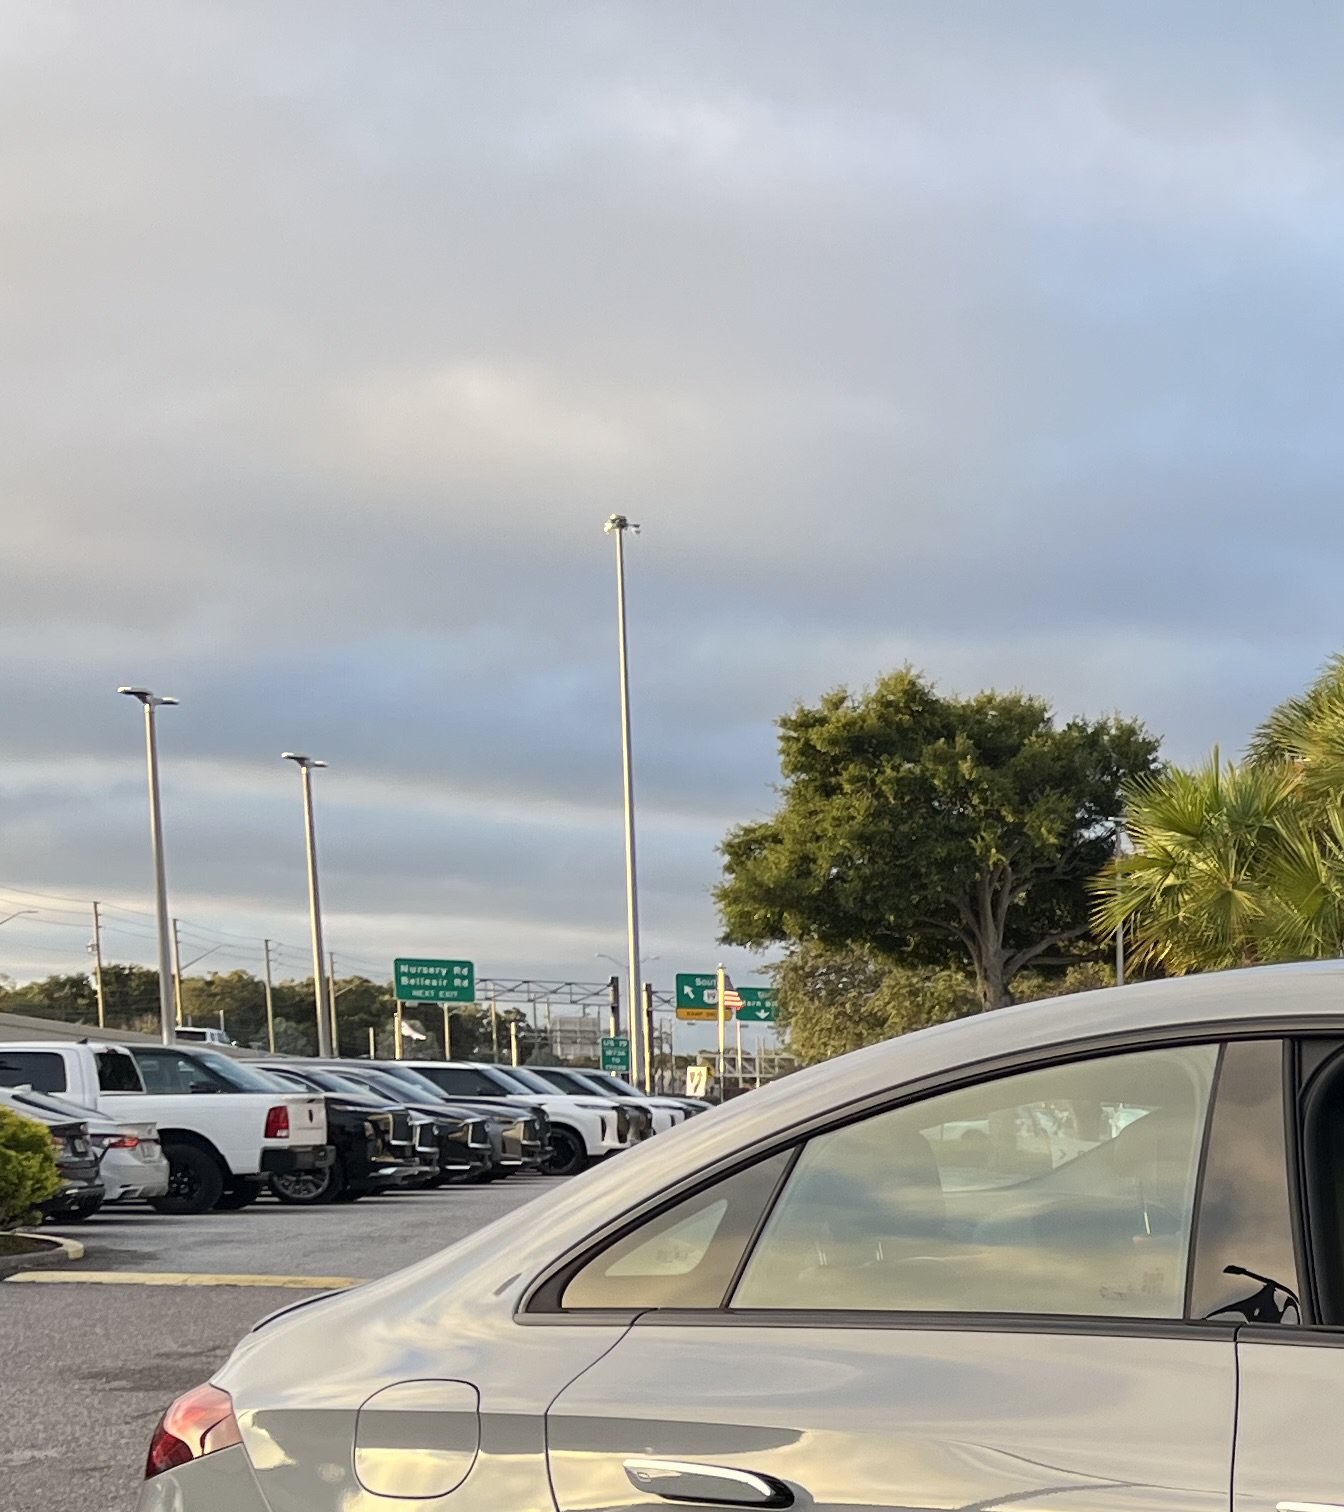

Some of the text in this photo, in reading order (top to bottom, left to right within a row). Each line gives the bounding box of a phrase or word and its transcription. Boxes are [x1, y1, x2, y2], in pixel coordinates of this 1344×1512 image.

[400, 964, 468, 976] Nursery Rd
[400, 976, 469, 987] Belleair Rd
